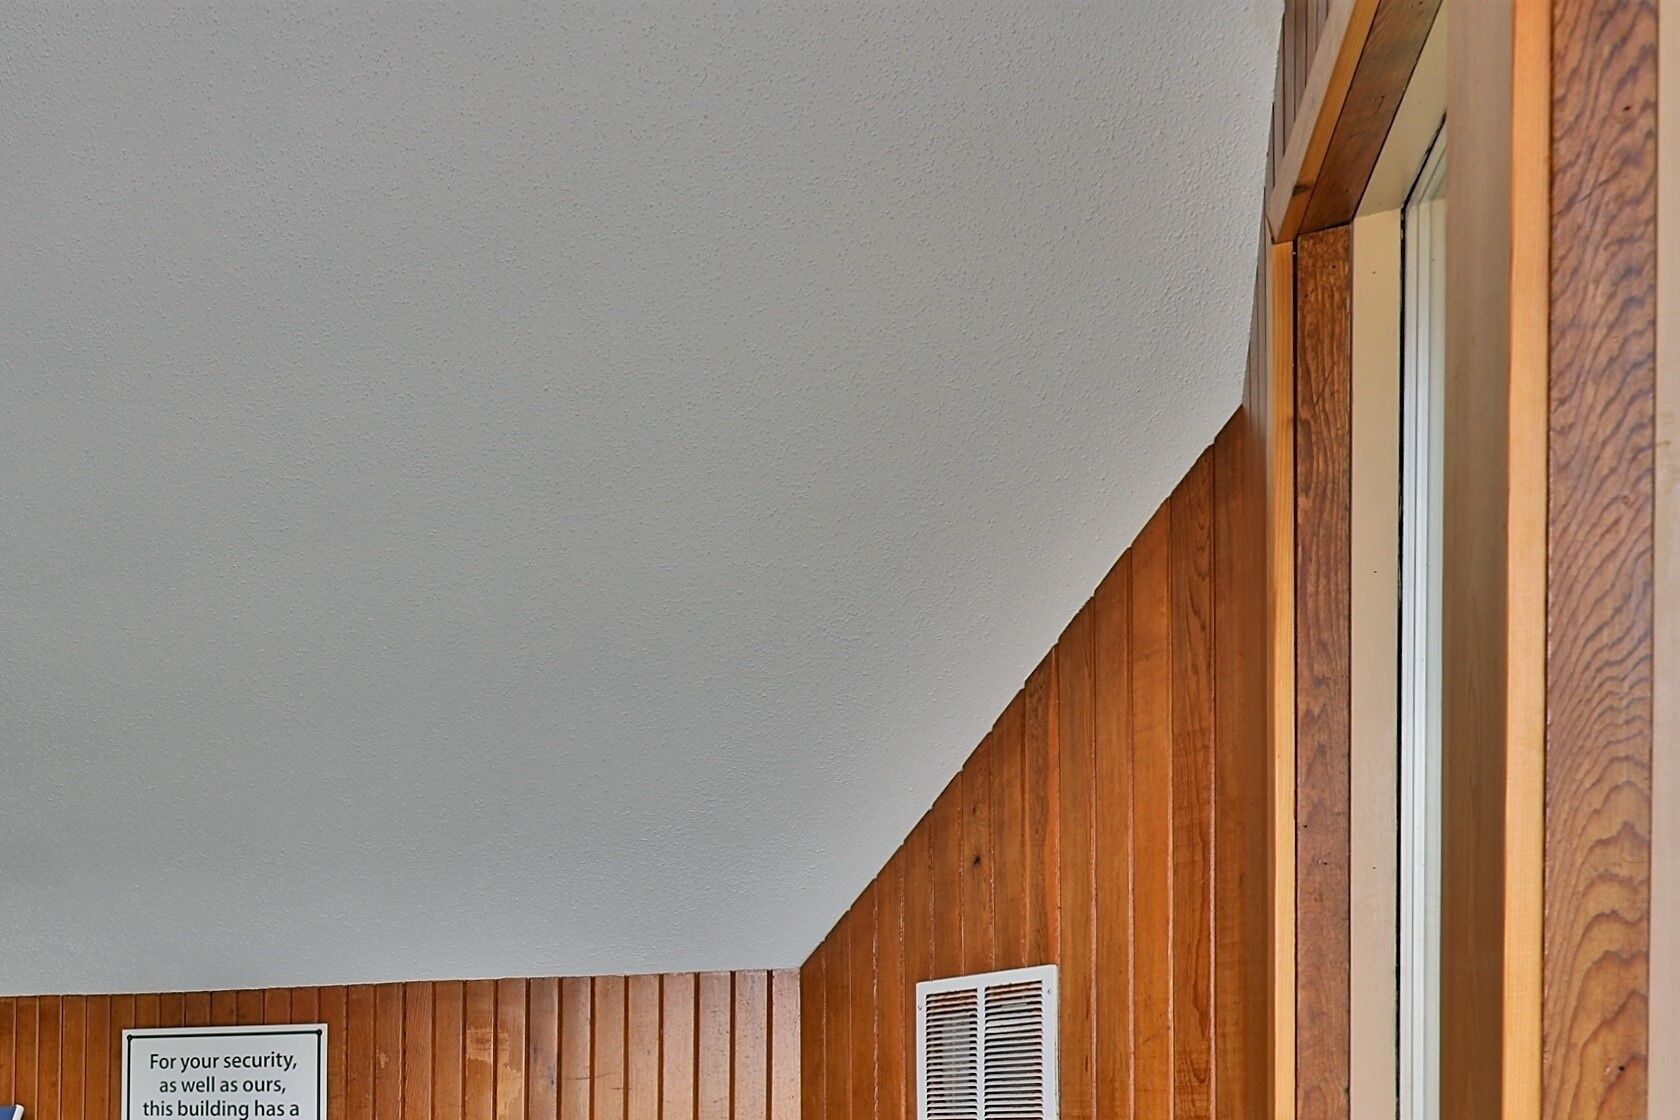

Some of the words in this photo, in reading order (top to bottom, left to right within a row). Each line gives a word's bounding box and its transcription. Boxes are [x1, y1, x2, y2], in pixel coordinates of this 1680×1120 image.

[150, 1054, 177, 1070] For
[180, 1056, 220, 1073] your
[223, 1051, 298, 1071] security,
[159, 1079, 177, 1093] as
[181, 1076, 215, 1093] well
[219, 1079, 238, 1093] as
[242, 1079, 286, 1094] ours,
[142, 1100, 173, 1117] this
[177, 1100, 249, 1120] building
[254, 1100, 285, 1117] has
[289, 1103, 300, 1117] a
